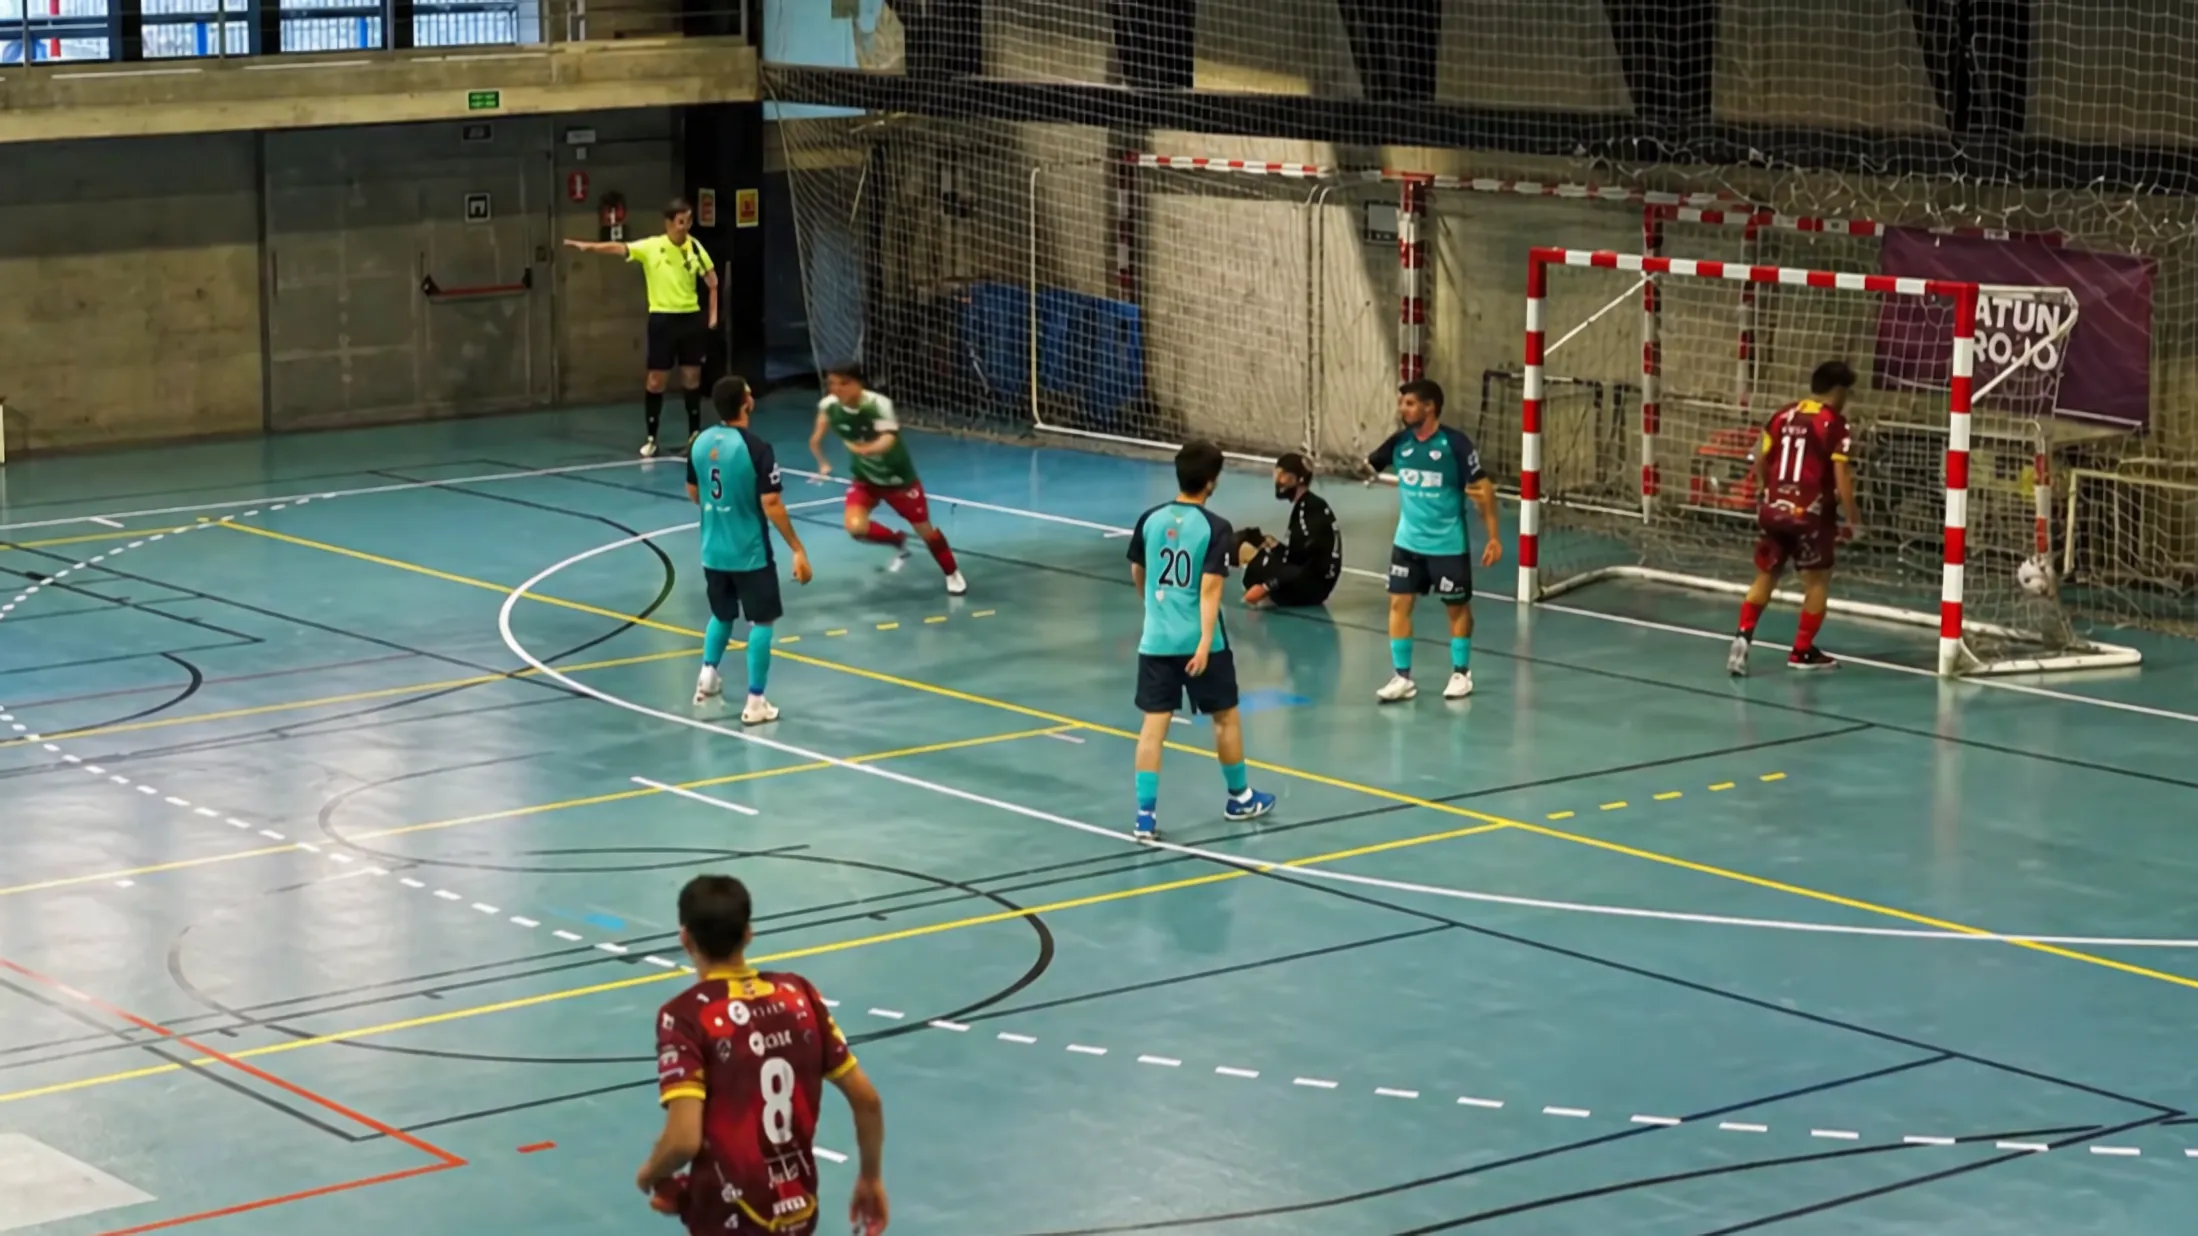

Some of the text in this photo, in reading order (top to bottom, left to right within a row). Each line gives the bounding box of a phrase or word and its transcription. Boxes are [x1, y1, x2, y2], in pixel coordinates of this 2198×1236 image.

[1975, 294, 2060, 337] ATUN
[1779, 436, 1806, 482] 11
[710, 468, 723, 500] 5
[1158, 547, 1193, 588] 20
[760, 1057, 795, 1144] 8
